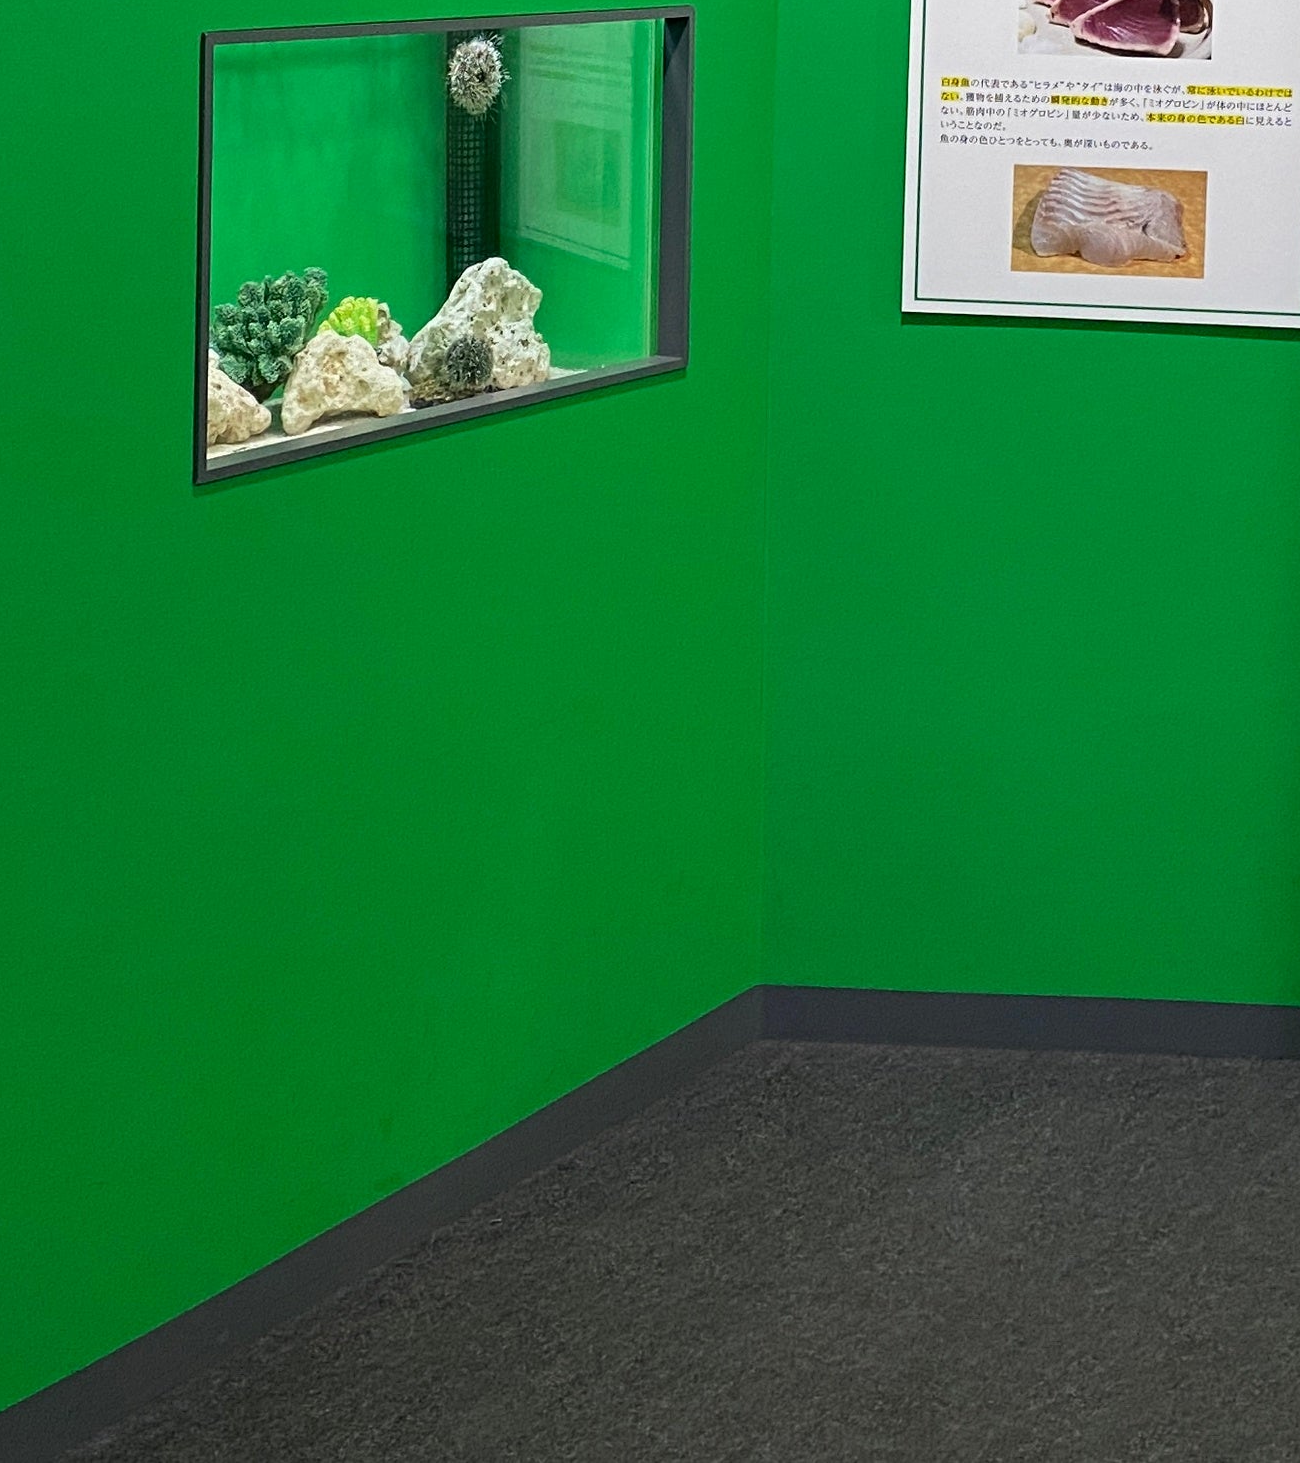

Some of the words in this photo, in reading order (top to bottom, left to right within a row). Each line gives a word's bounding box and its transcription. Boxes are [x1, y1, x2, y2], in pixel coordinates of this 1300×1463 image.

[940, 119, 1007, 132] いうことなのだ。
